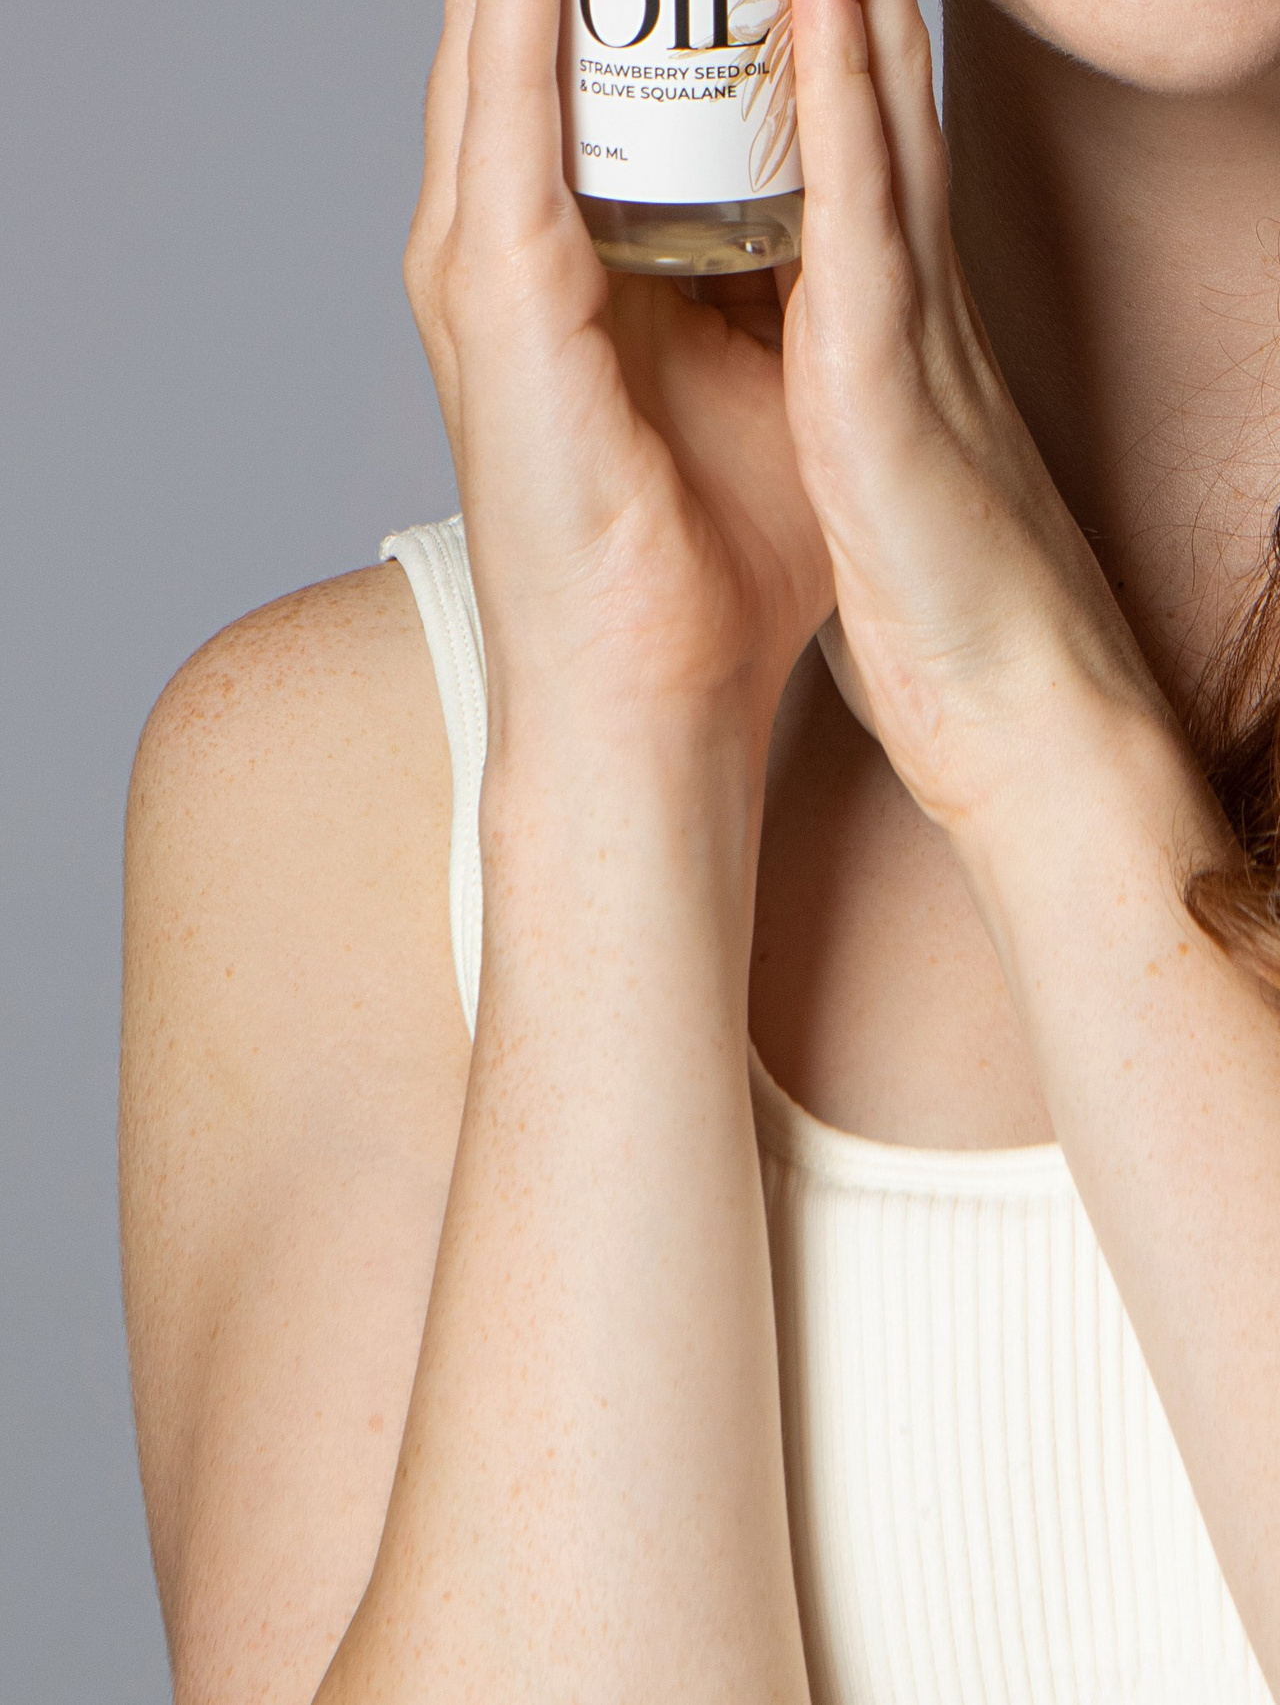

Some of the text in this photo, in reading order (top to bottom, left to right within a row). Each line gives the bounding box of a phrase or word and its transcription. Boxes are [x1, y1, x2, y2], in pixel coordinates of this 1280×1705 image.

[580, 59, 770, 80] STRAWBERRY SEED OIL
[579, 79, 738, 103] & OLIVE SQUALANE
[580, 141, 629, 161] 100 ML
